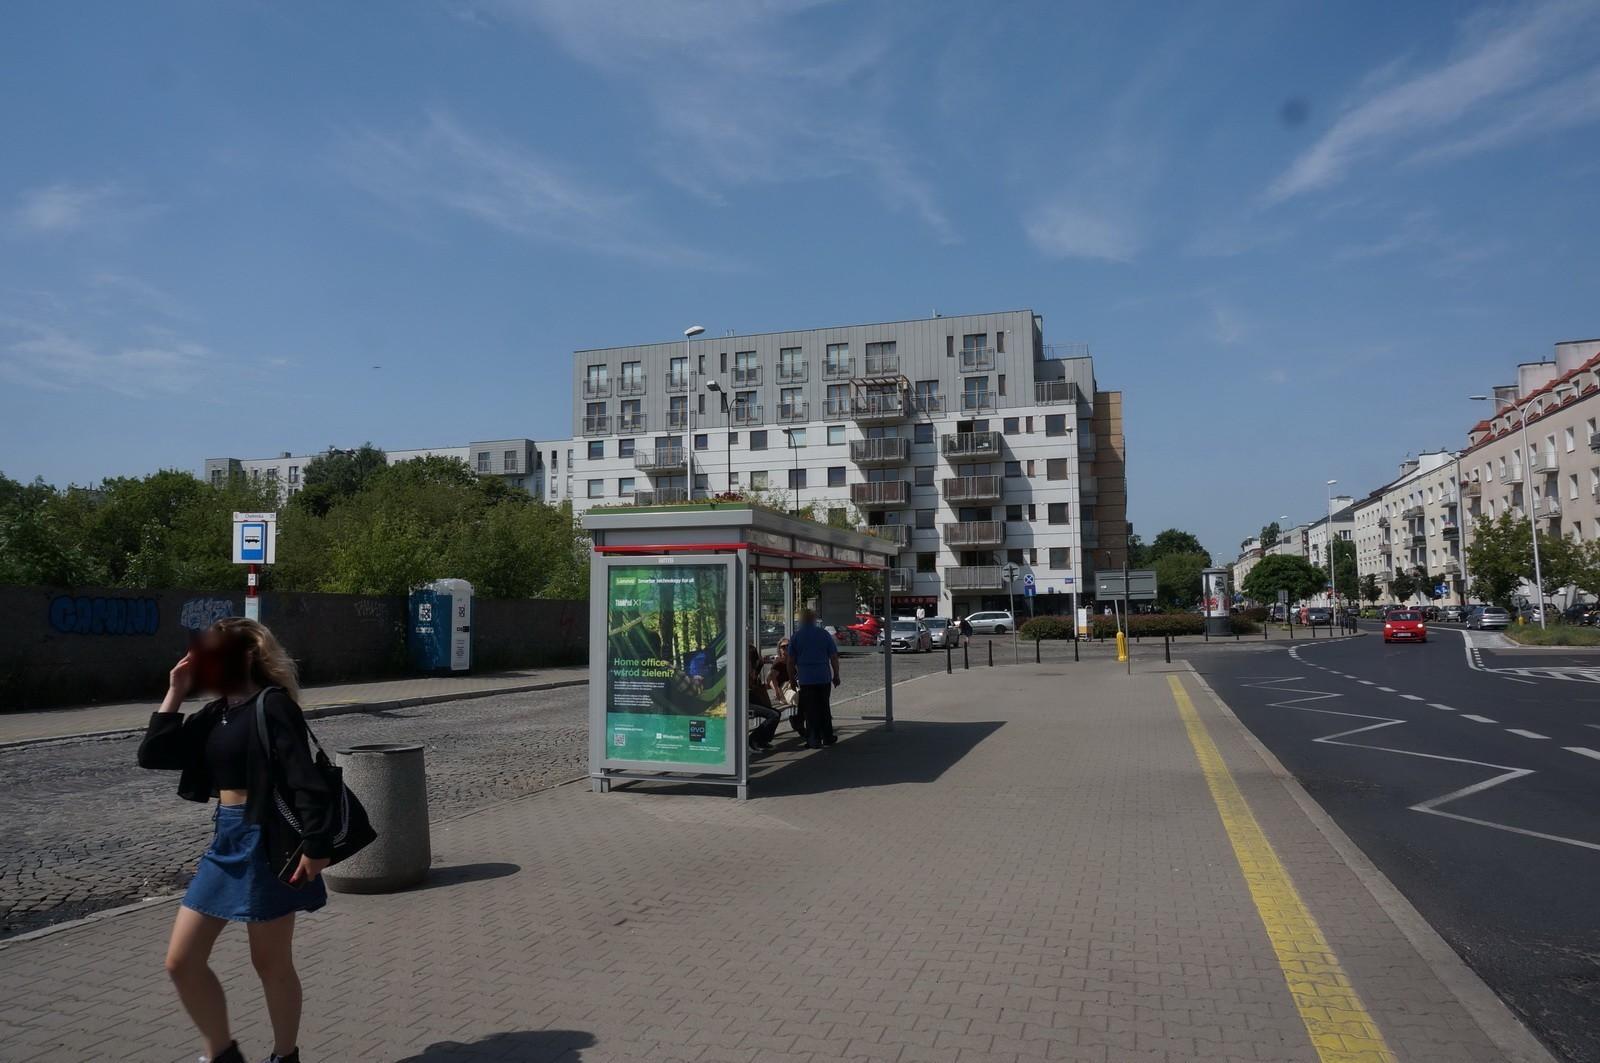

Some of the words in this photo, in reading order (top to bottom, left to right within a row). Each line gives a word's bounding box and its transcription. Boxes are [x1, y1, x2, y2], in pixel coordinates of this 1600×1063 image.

[613, 657, 639, 666] Home
[641, 658, 666, 667] office
[613, 668, 640, 677] wśród
[641, 668, 675, 678] zieleni?
